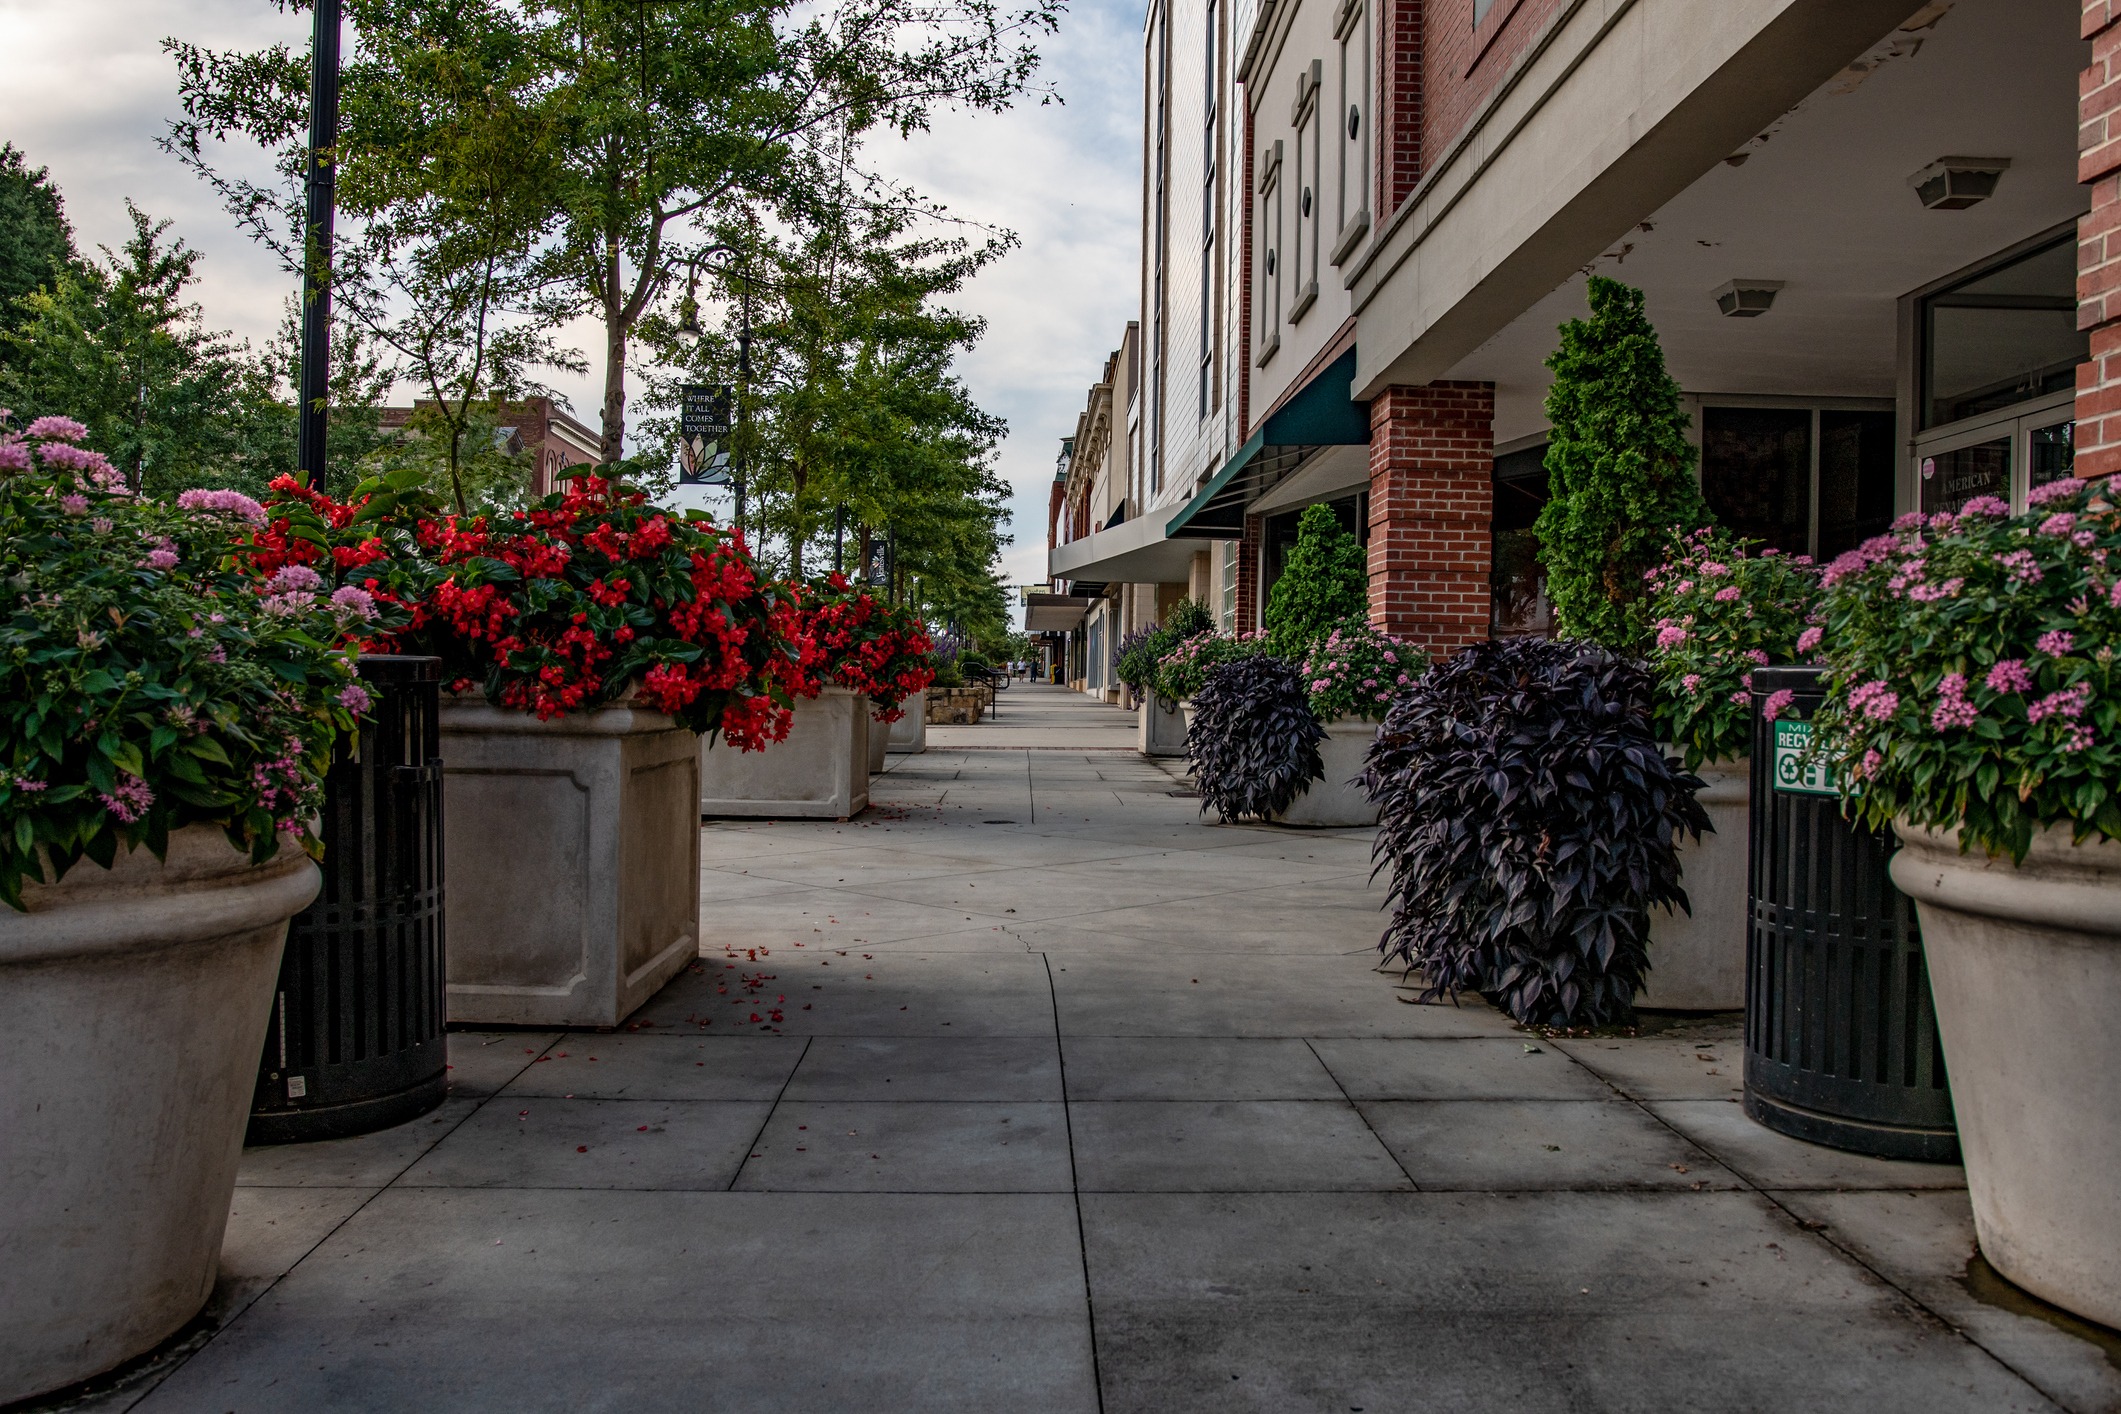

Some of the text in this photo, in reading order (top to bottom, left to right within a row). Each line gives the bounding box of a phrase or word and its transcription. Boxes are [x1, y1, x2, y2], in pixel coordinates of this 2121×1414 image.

[687, 395, 715, 403] WHERE
[694, 405, 710, 413] ALL
[685, 425, 728, 433] TOGETHER
[1942, 471, 1992, 495] AMERICAN
